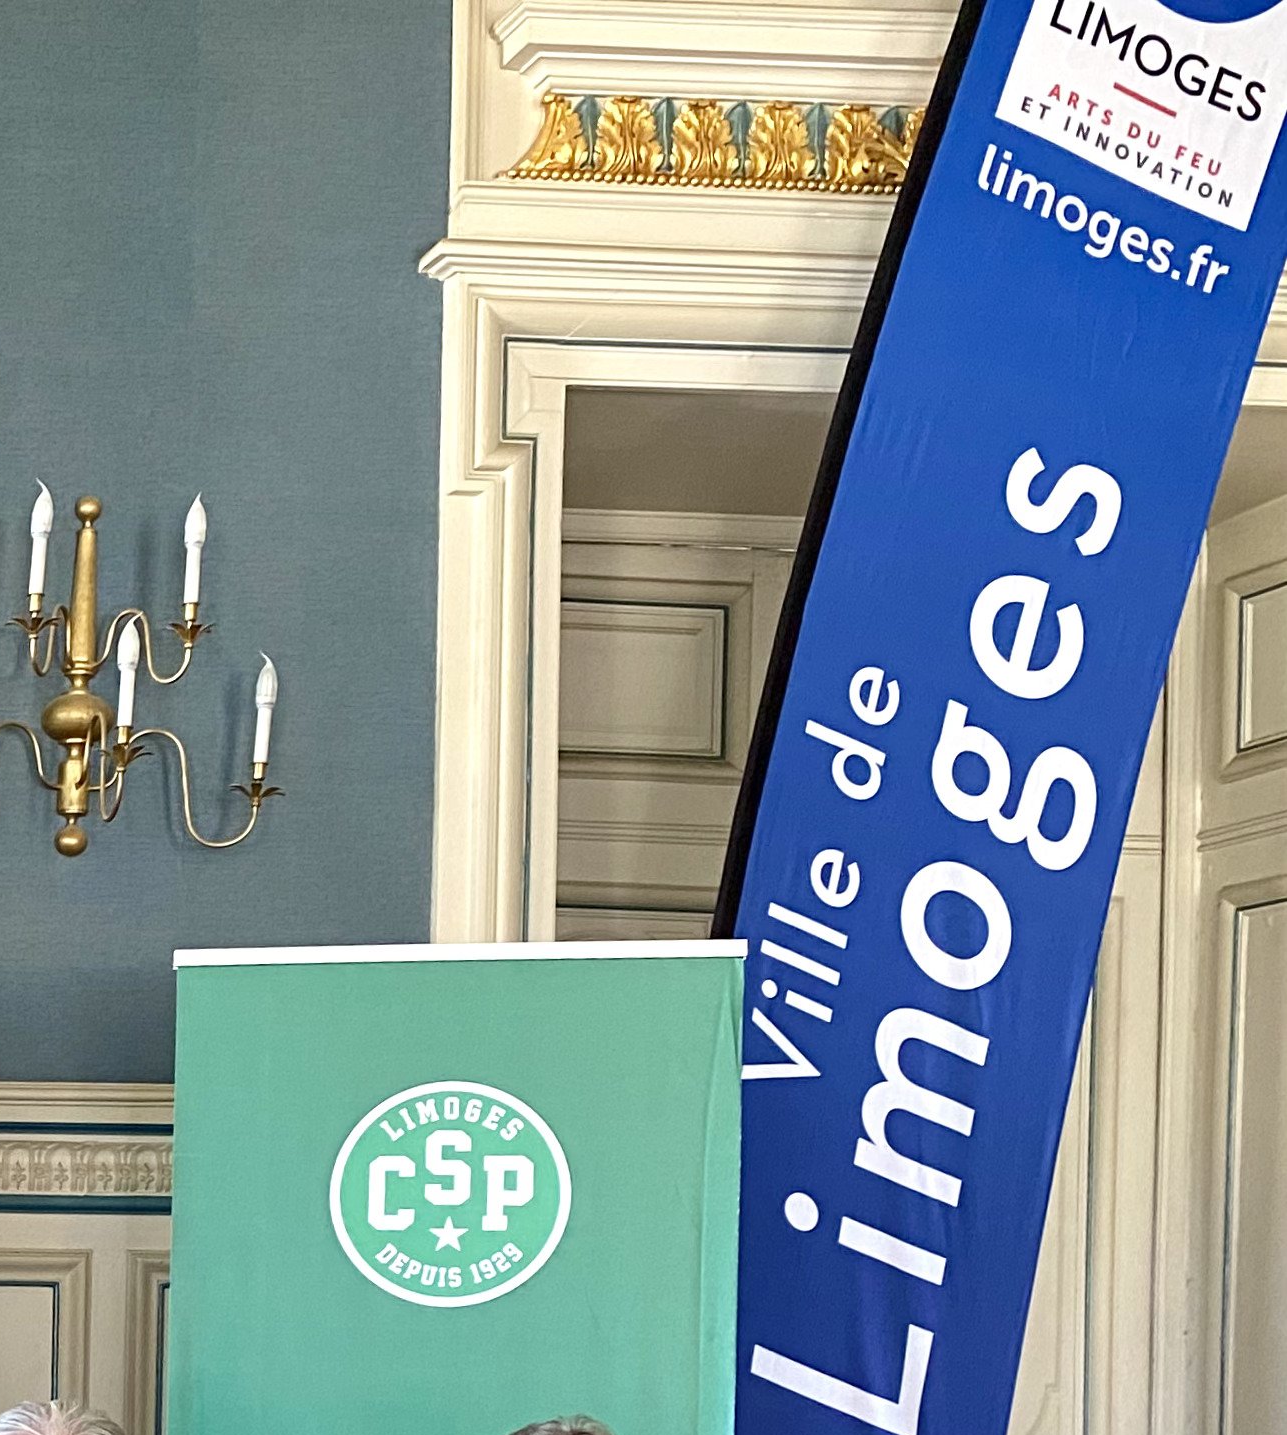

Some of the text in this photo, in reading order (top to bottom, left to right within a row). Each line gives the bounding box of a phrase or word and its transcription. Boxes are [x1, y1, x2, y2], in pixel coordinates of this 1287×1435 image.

[1049, 0, 1266, 122] LIMOGES
[1020, 96, 1234, 208] ET INNOVATION
[1048, 83, 1222, 176] ARTS DU FEU
[977, 143, 1230, 294] limoges.fr
[741, 665, 900, 1080] Ville de
[378, 1096, 525, 1142] LIMOGES
[367, 1129, 535, 1231] CSP
[375, 1242, 524, 1288] DEPUIS 1929
